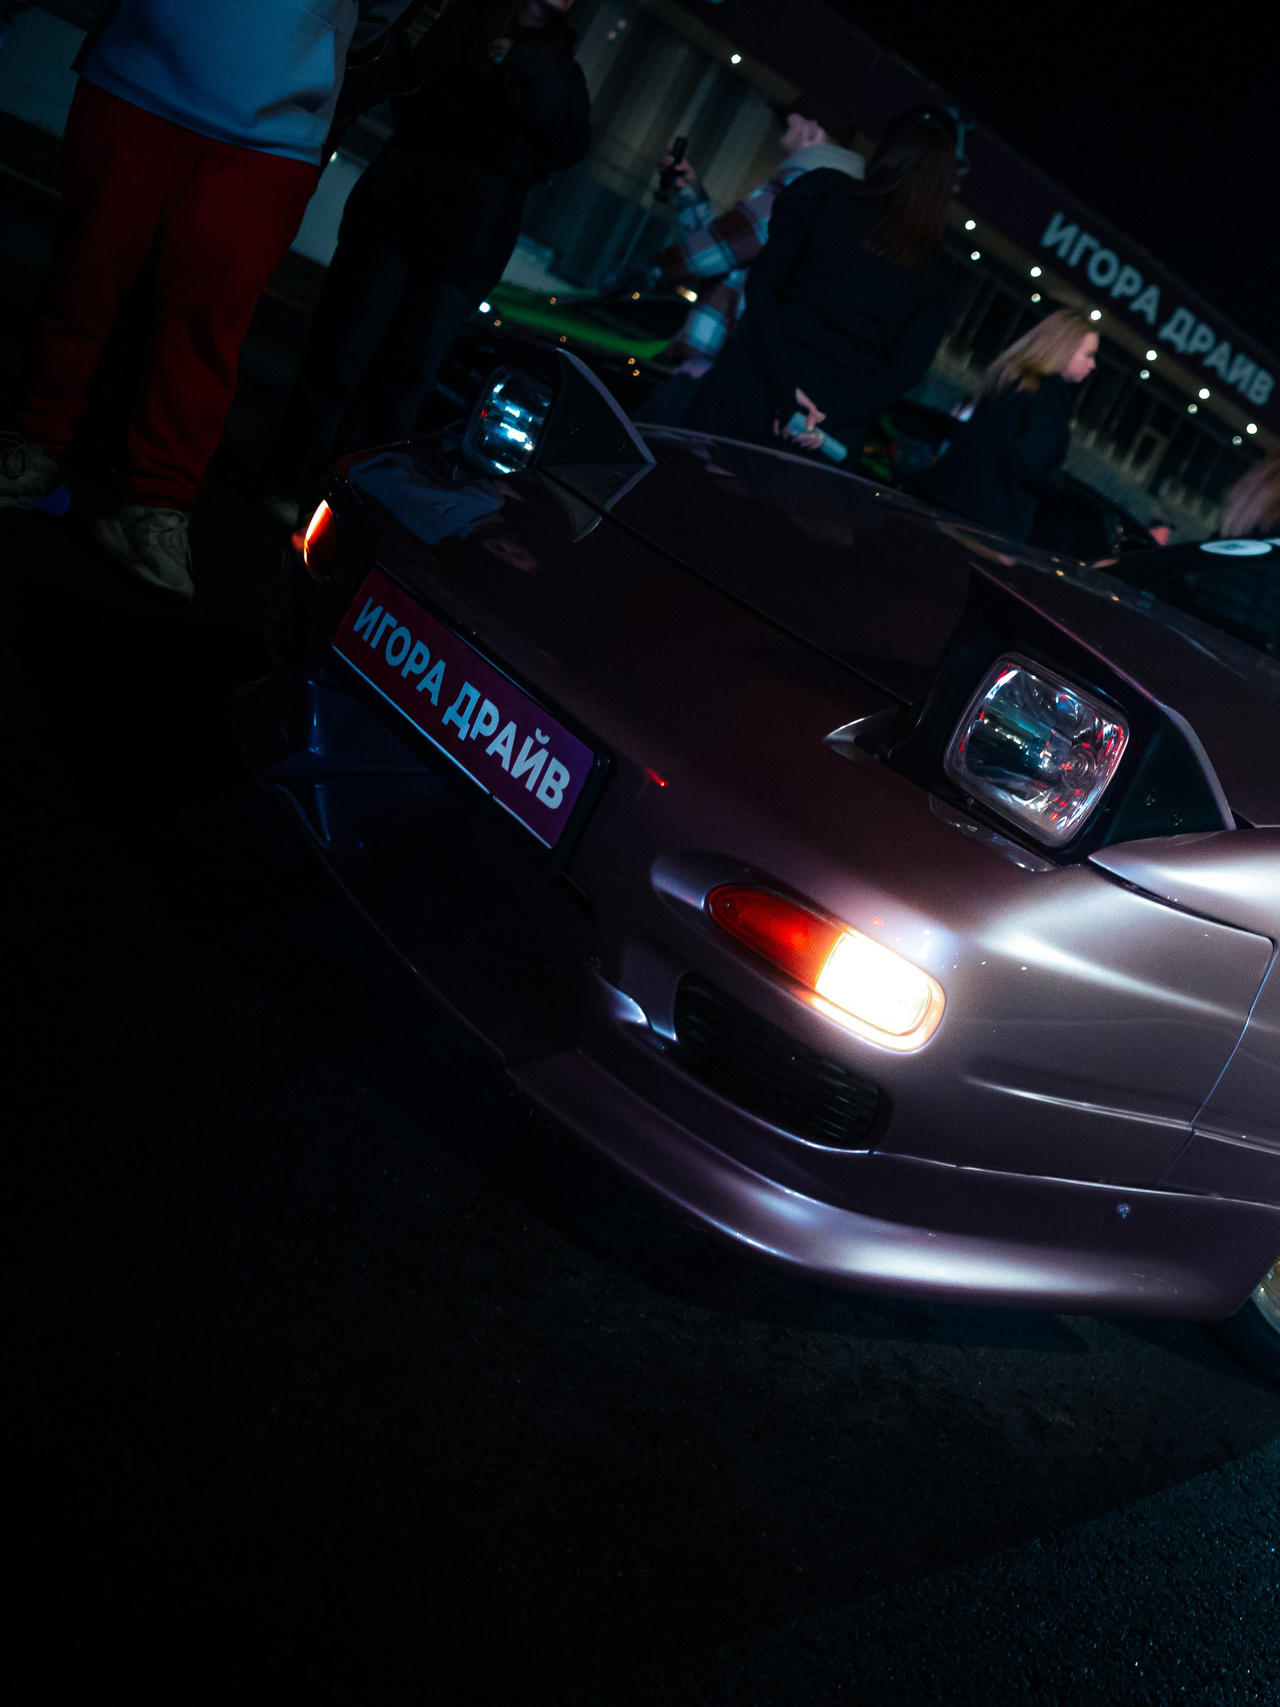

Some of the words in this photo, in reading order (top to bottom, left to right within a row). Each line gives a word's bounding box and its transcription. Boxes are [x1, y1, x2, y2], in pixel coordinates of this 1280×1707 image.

[1040, 211, 1161, 325] ИГОРА
[353, 596, 446, 706] ИГОРА
[442, 681, 570, 810] ДРАЙВ
